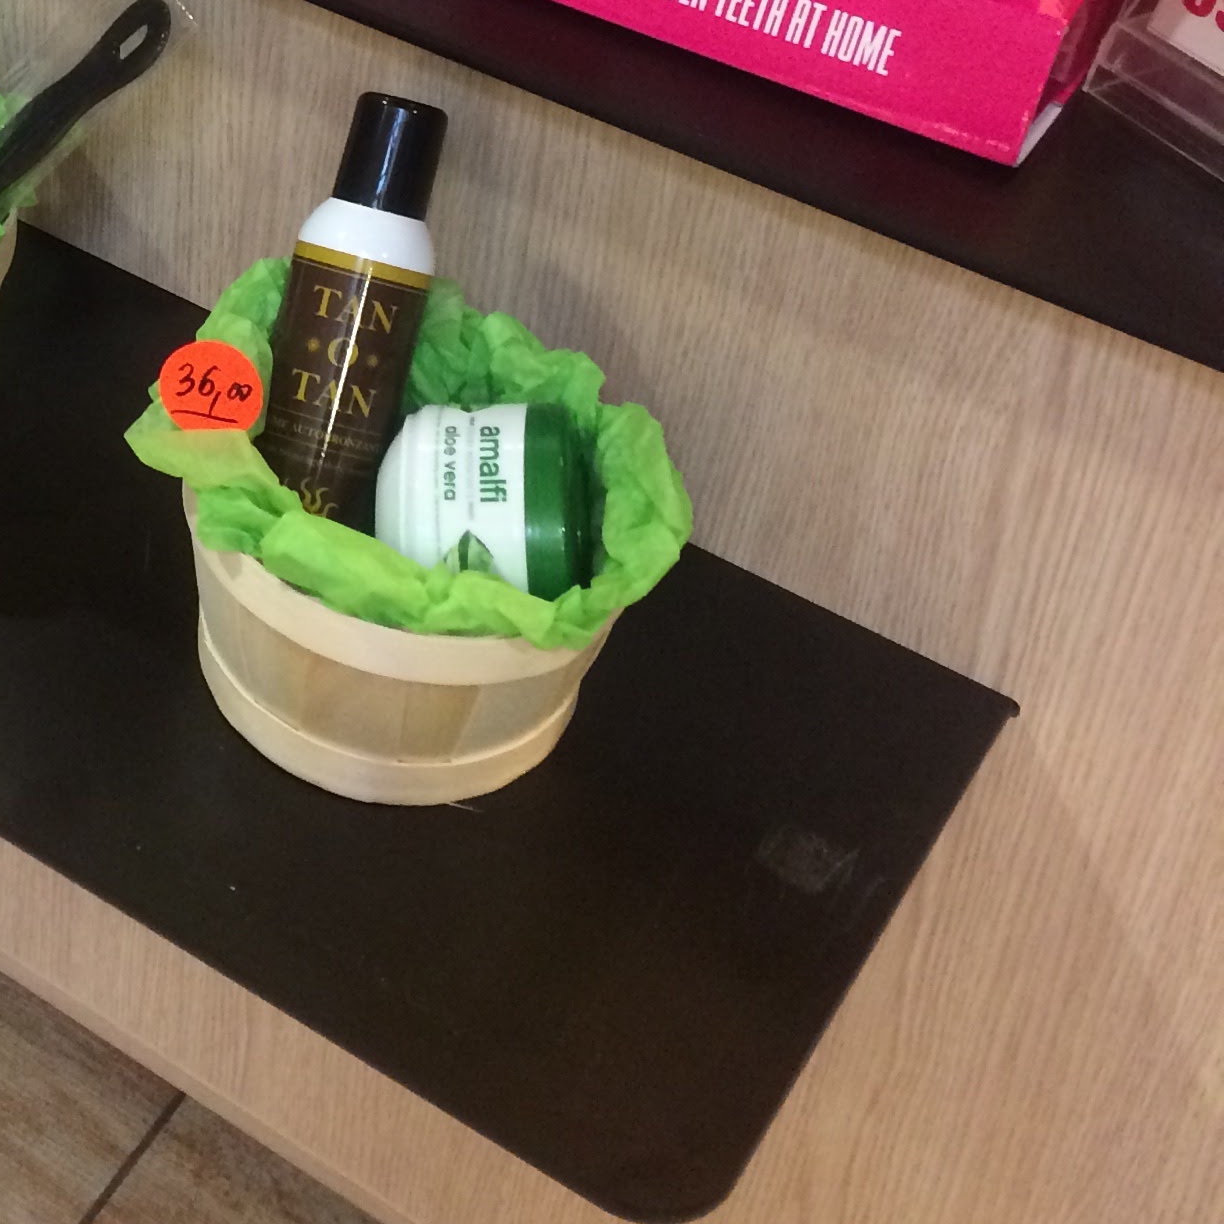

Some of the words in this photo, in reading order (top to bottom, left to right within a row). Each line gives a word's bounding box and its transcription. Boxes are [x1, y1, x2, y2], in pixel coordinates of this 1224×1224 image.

[820, 8, 902, 76] HOME
[313, 284, 398, 335] TAN
[327, 337, 359, 369] O
[175, 362, 253, 417] 36,00
[292, 367, 376, 418] TAN
[443, 426, 461, 456] aloe
[479, 425, 508, 503] amalfi
[443, 460, 457, 501] vera
